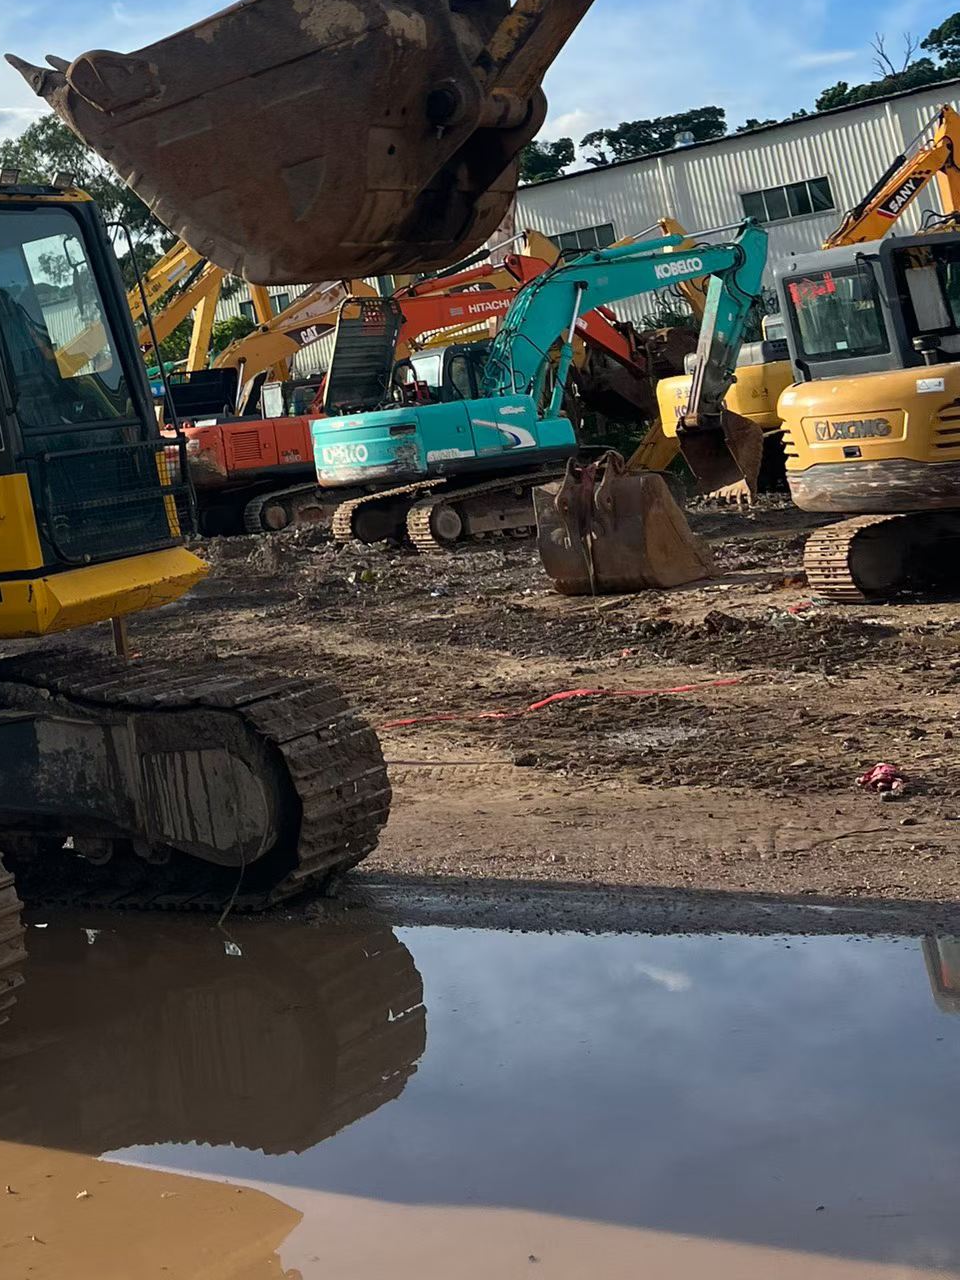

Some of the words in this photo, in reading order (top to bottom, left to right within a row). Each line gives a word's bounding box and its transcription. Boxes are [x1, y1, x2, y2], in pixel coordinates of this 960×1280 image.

[889, 179, 916, 213] SANY
[654, 257, 703, 279] KOBELCO
[468, 299, 510, 314] HITACHI
[300, 325, 319, 344] CAT
